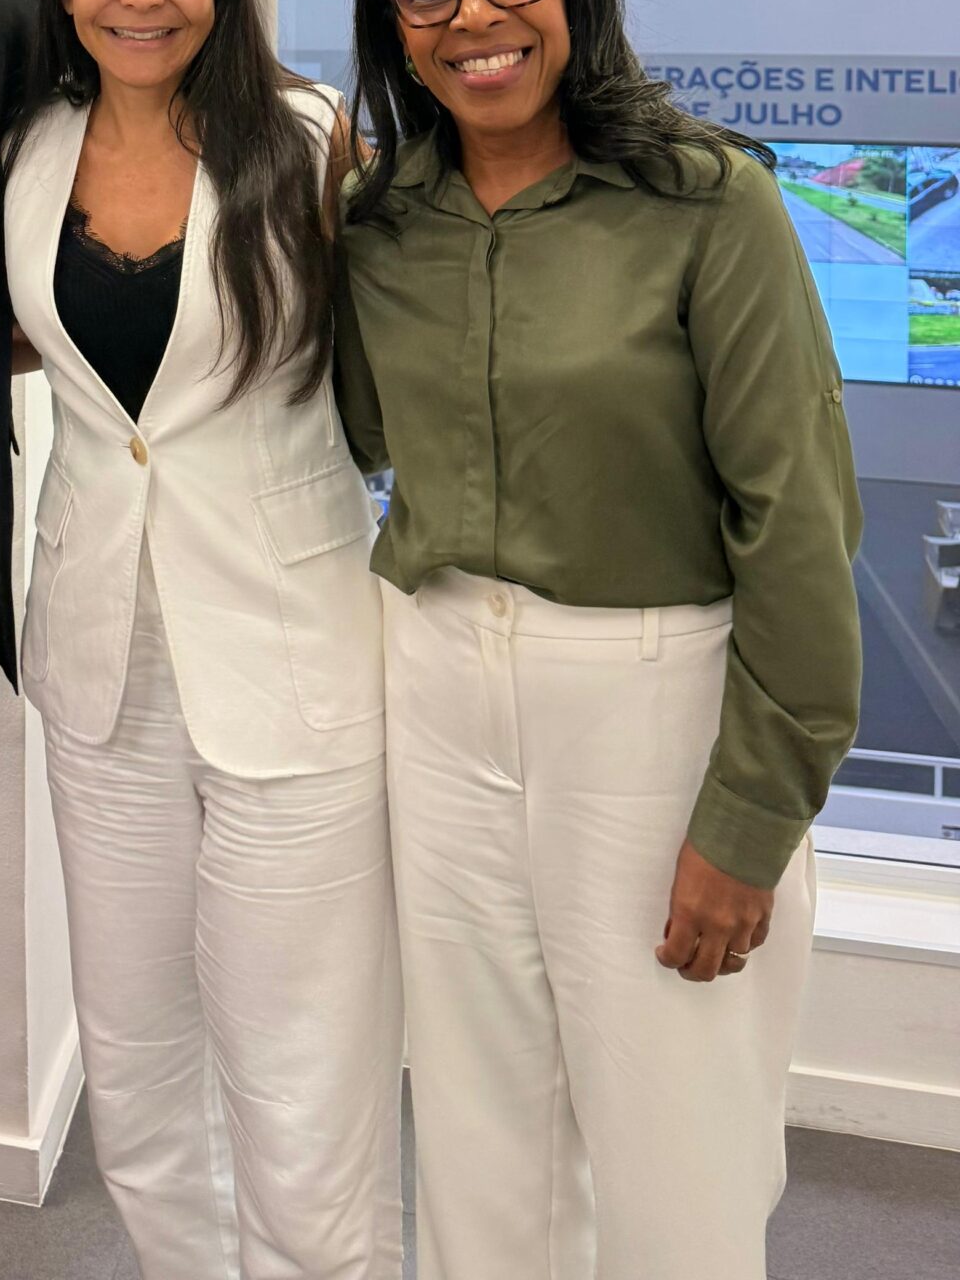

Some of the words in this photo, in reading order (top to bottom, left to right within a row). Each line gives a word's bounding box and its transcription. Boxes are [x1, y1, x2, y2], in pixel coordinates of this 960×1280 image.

[815, 67, 835, 92] E
[845, 67, 960, 94] INTELI
[722, 102, 843, 126] JULHO
